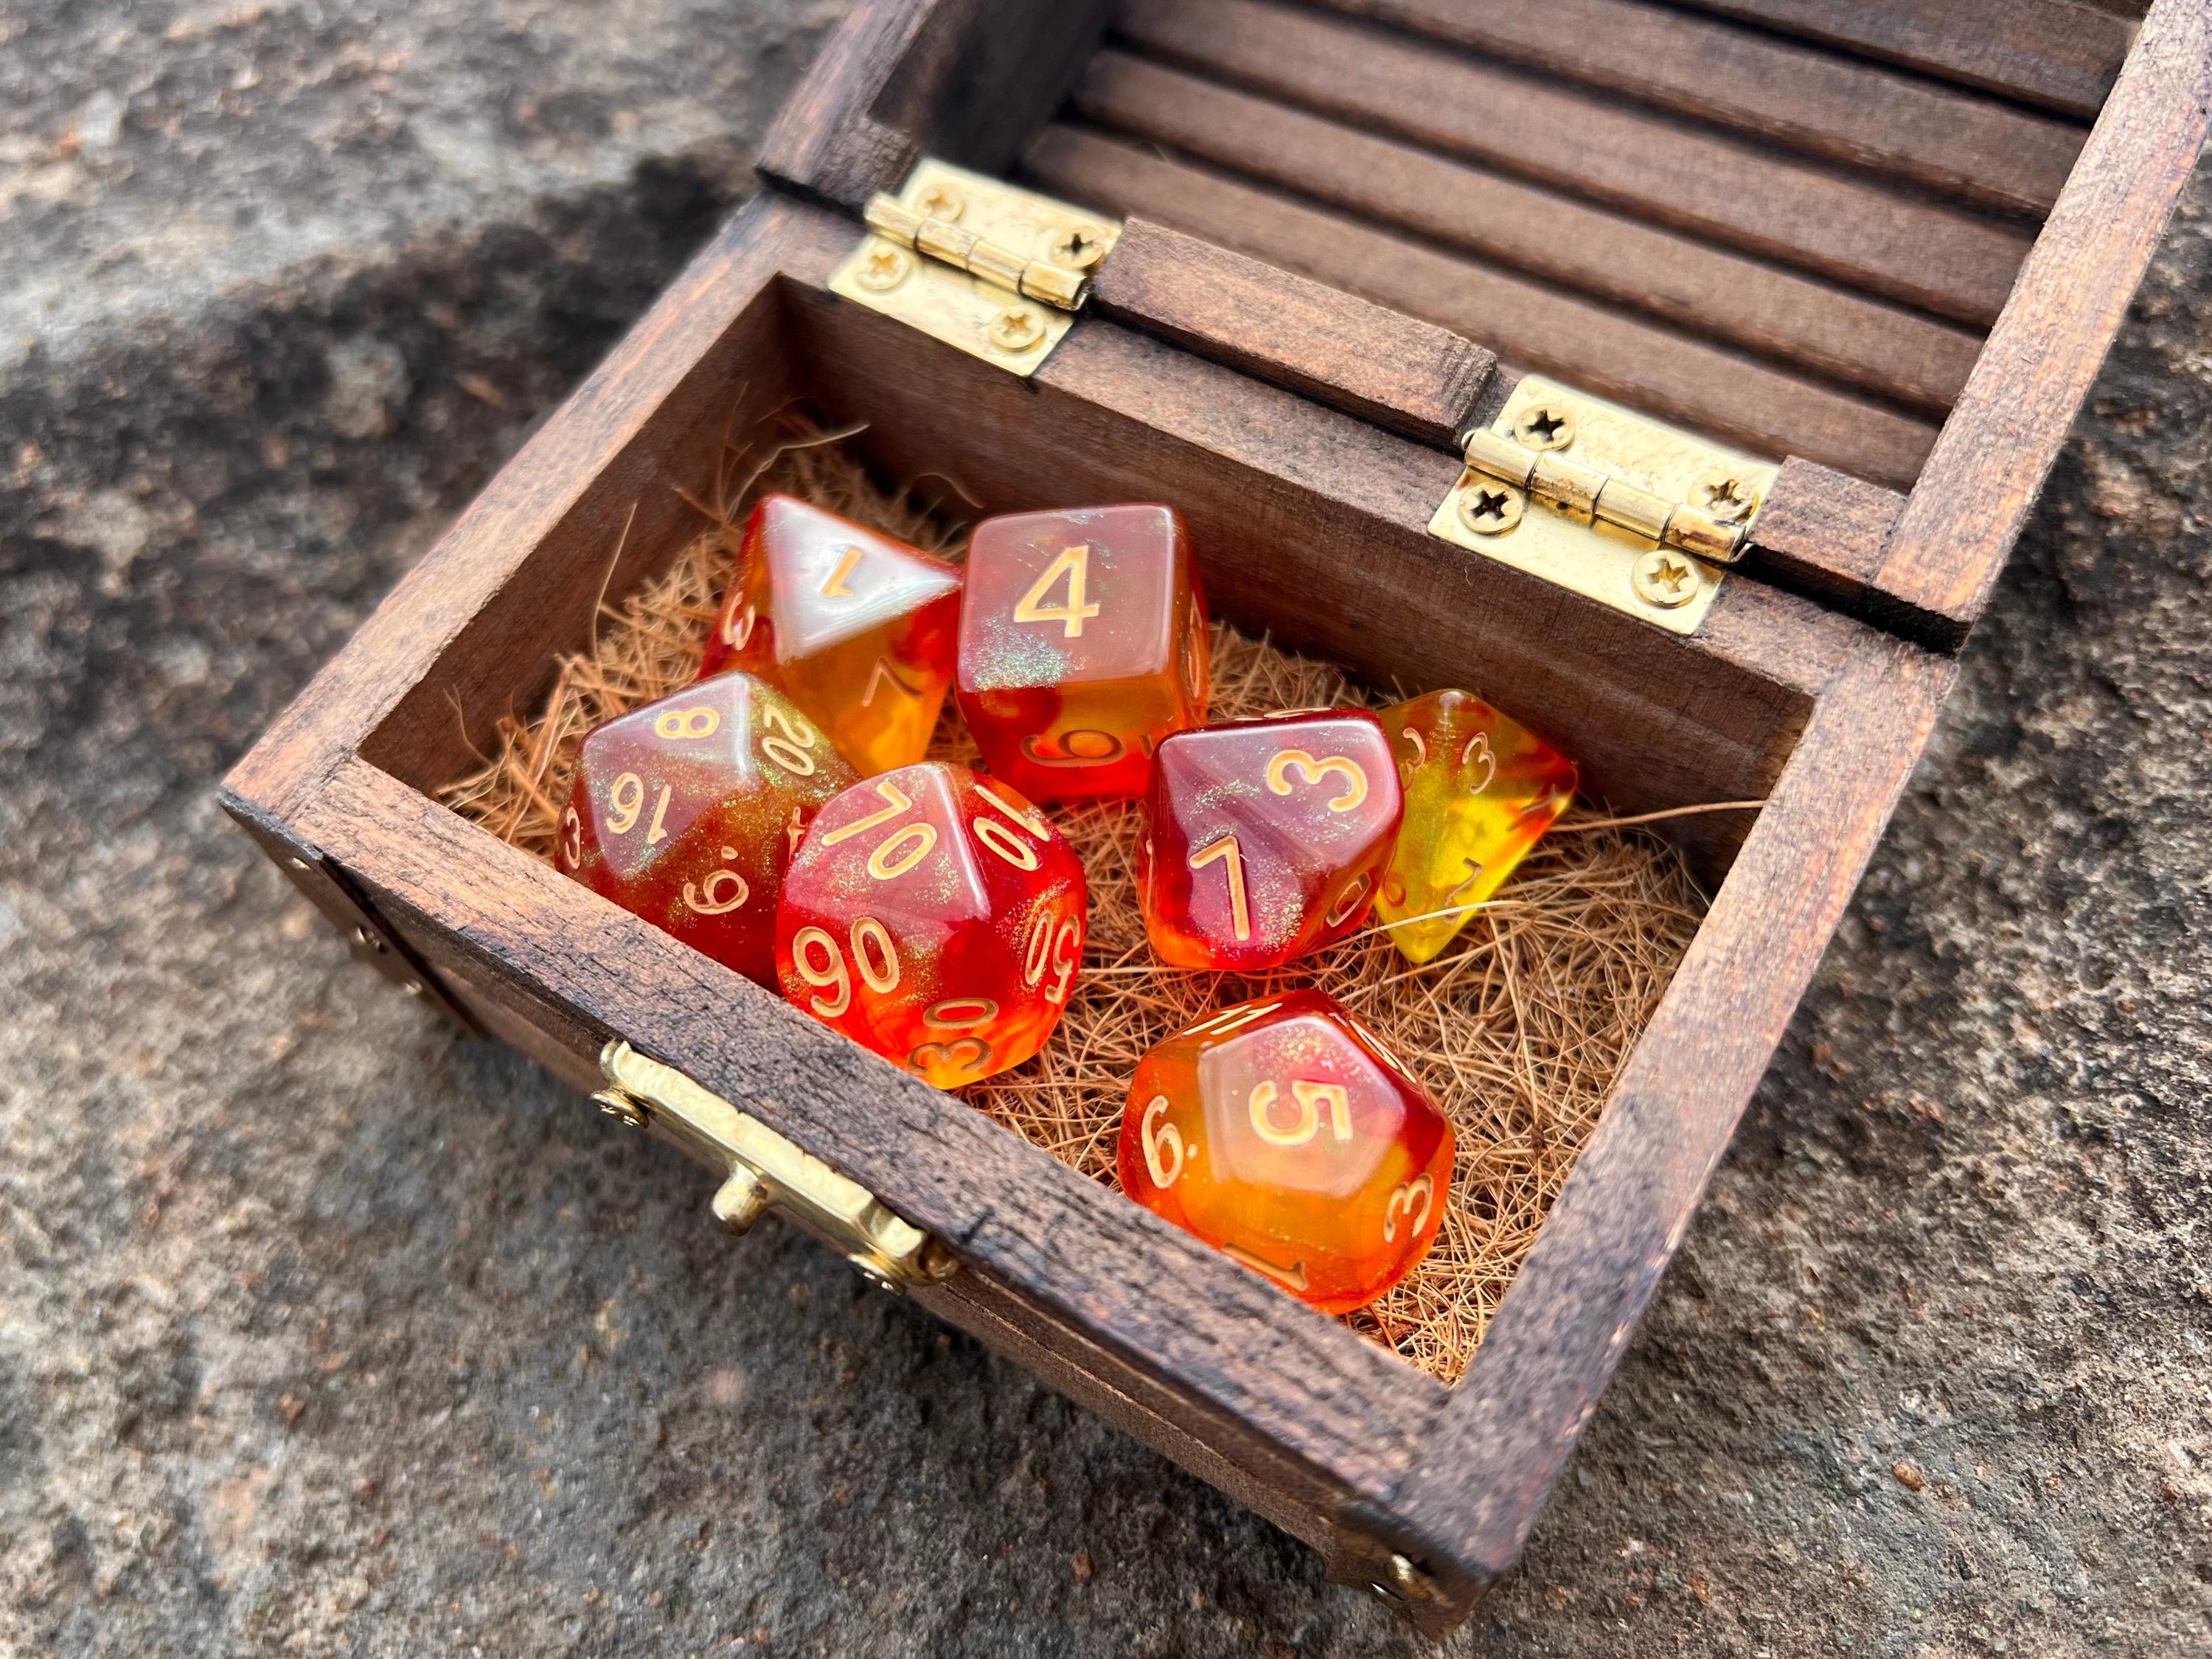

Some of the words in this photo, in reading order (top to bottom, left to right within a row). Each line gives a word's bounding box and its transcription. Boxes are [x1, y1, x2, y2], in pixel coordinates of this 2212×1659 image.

[1014, 545, 1099, 638] 4
[655, 707, 720, 739] 8
[762, 704, 815, 776] 20
[1266, 749, 1368, 812] 3
[1462, 731, 1496, 794] 3
[606, 772, 672, 844] 16
[821, 782, 937, 880] 70
[973, 785, 1049, 871] 10
[1189, 835, 1250, 941] 7
[793, 917, 900, 1017] 90
[1025, 910, 1080, 1004] 50
[908, 998, 1000, 1075] 30
[1181, 1003, 1284, 1035] 11
[1249, 1079, 1353, 1146] 5
[1383, 1174, 1434, 1243] 3
